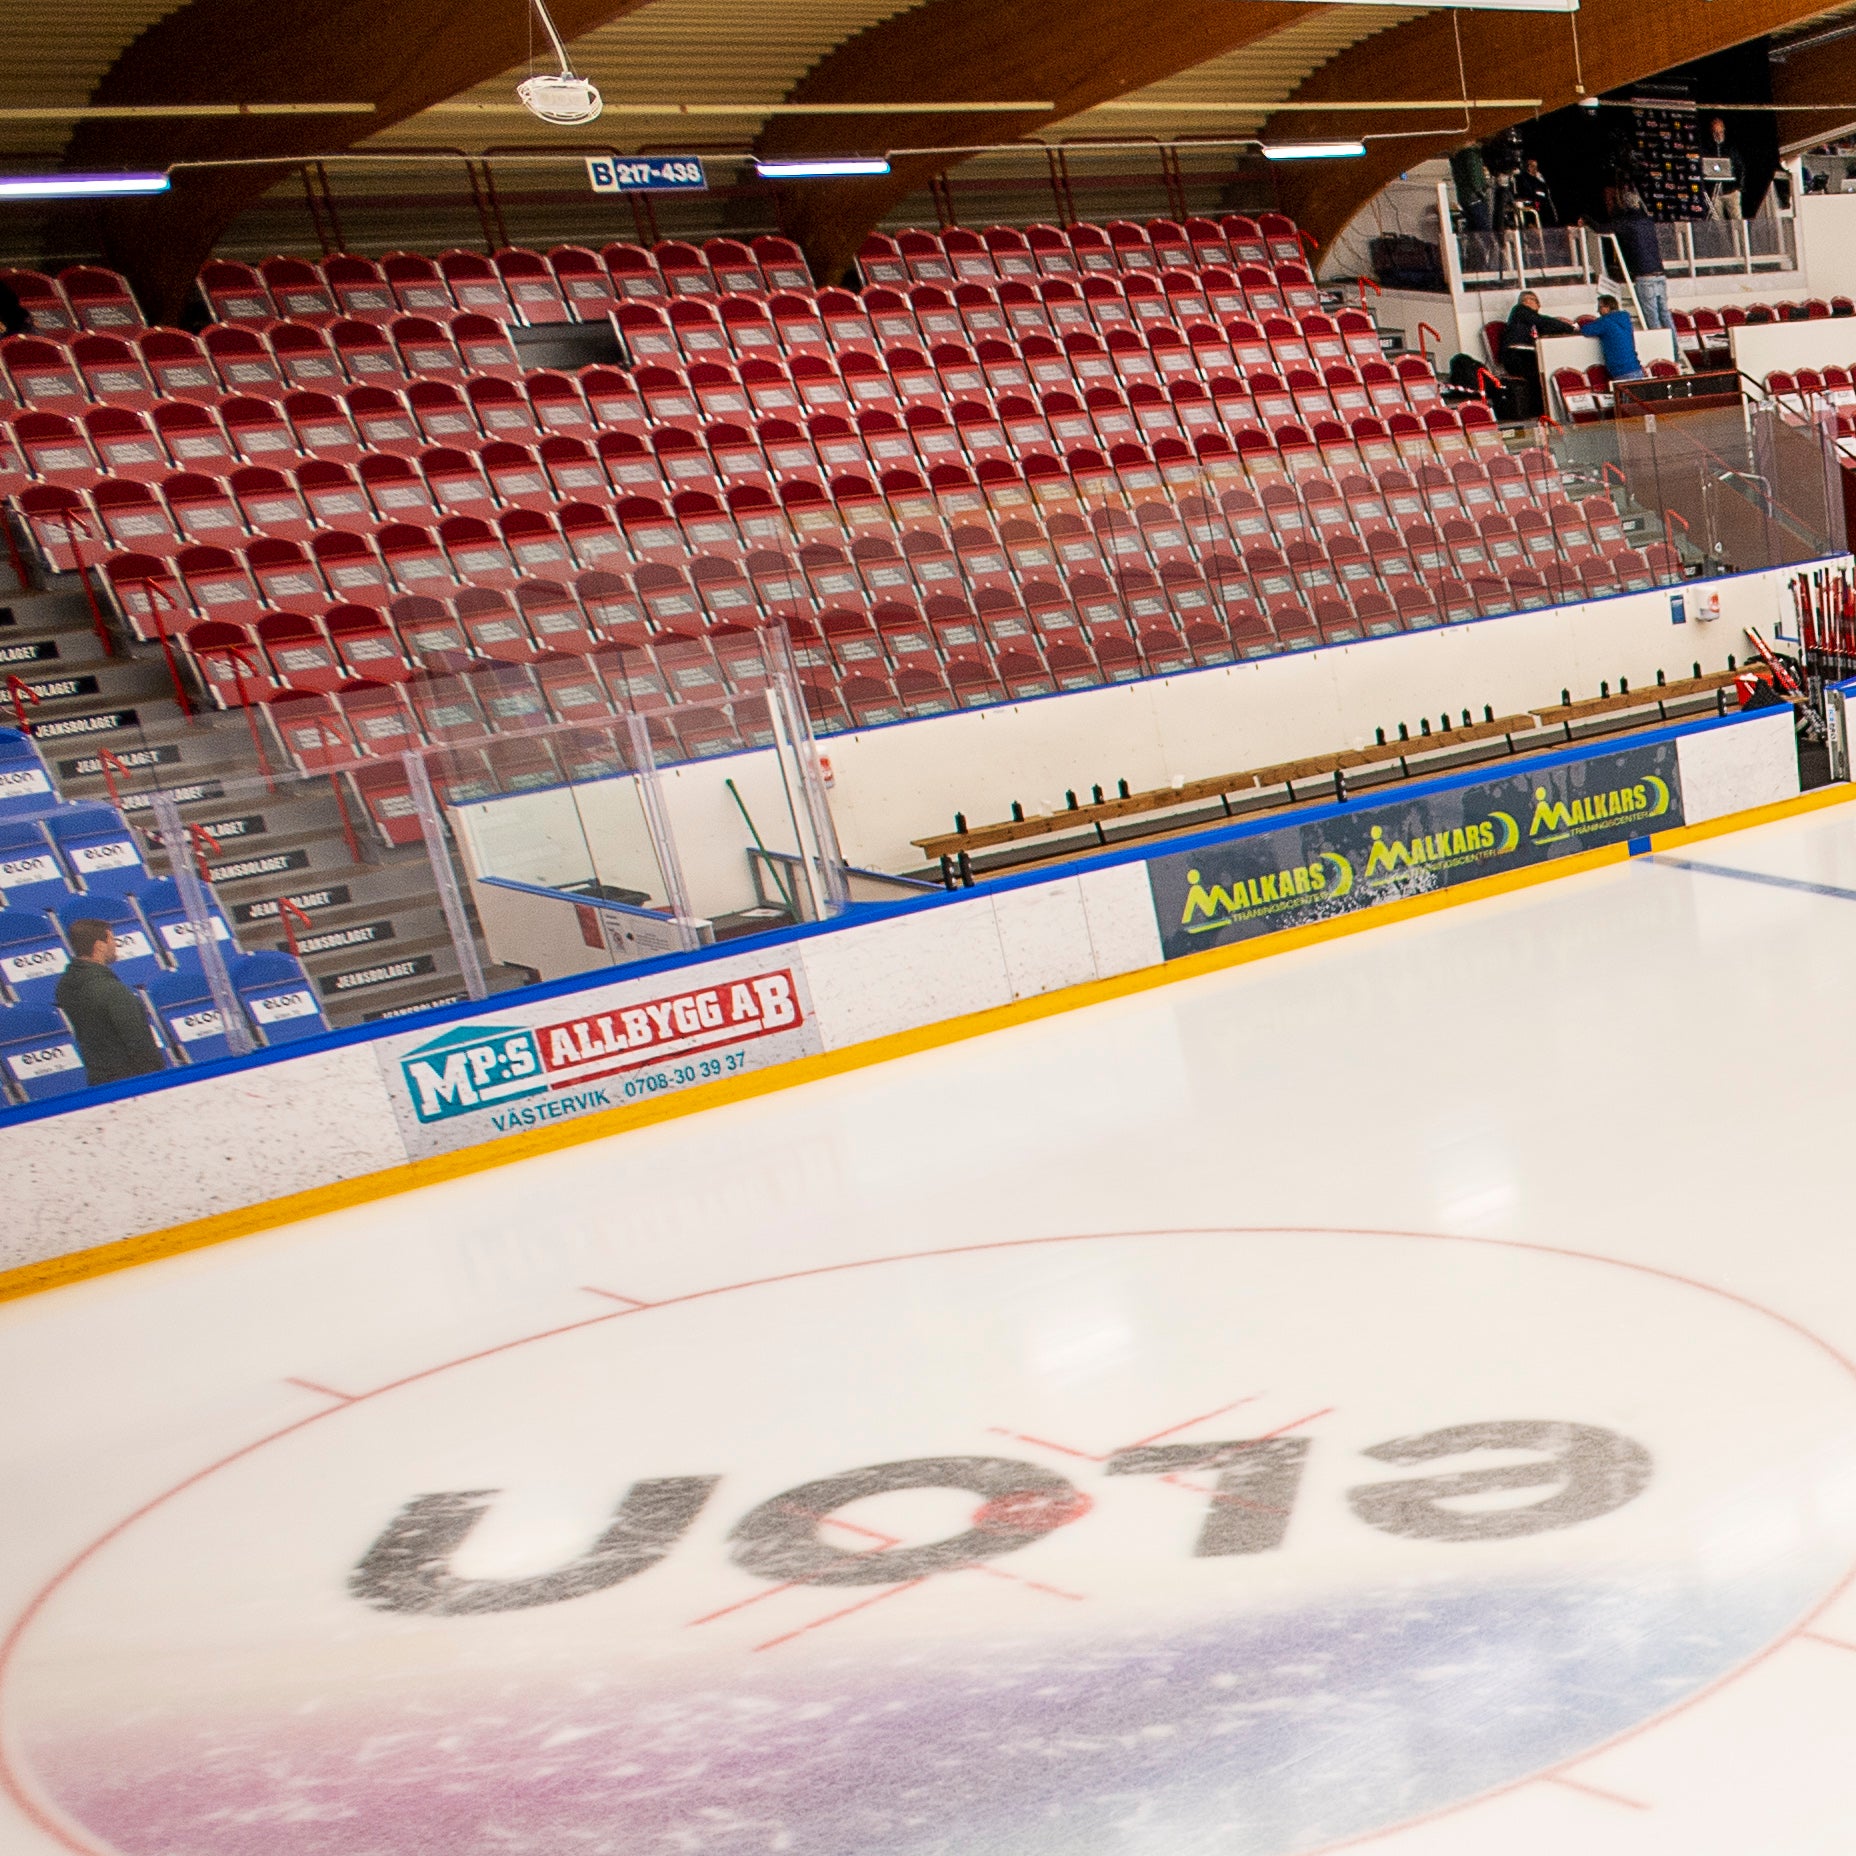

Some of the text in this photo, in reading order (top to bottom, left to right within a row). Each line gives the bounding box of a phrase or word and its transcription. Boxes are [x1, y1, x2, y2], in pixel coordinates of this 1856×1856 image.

[591, 162, 702, 186] B 217-438
[550, 994, 722, 1067] ALLBYGG
[731, 973, 796, 1031] AB
[491, 1050, 746, 1132] VÄSTERVIK 0708-30 39 37
